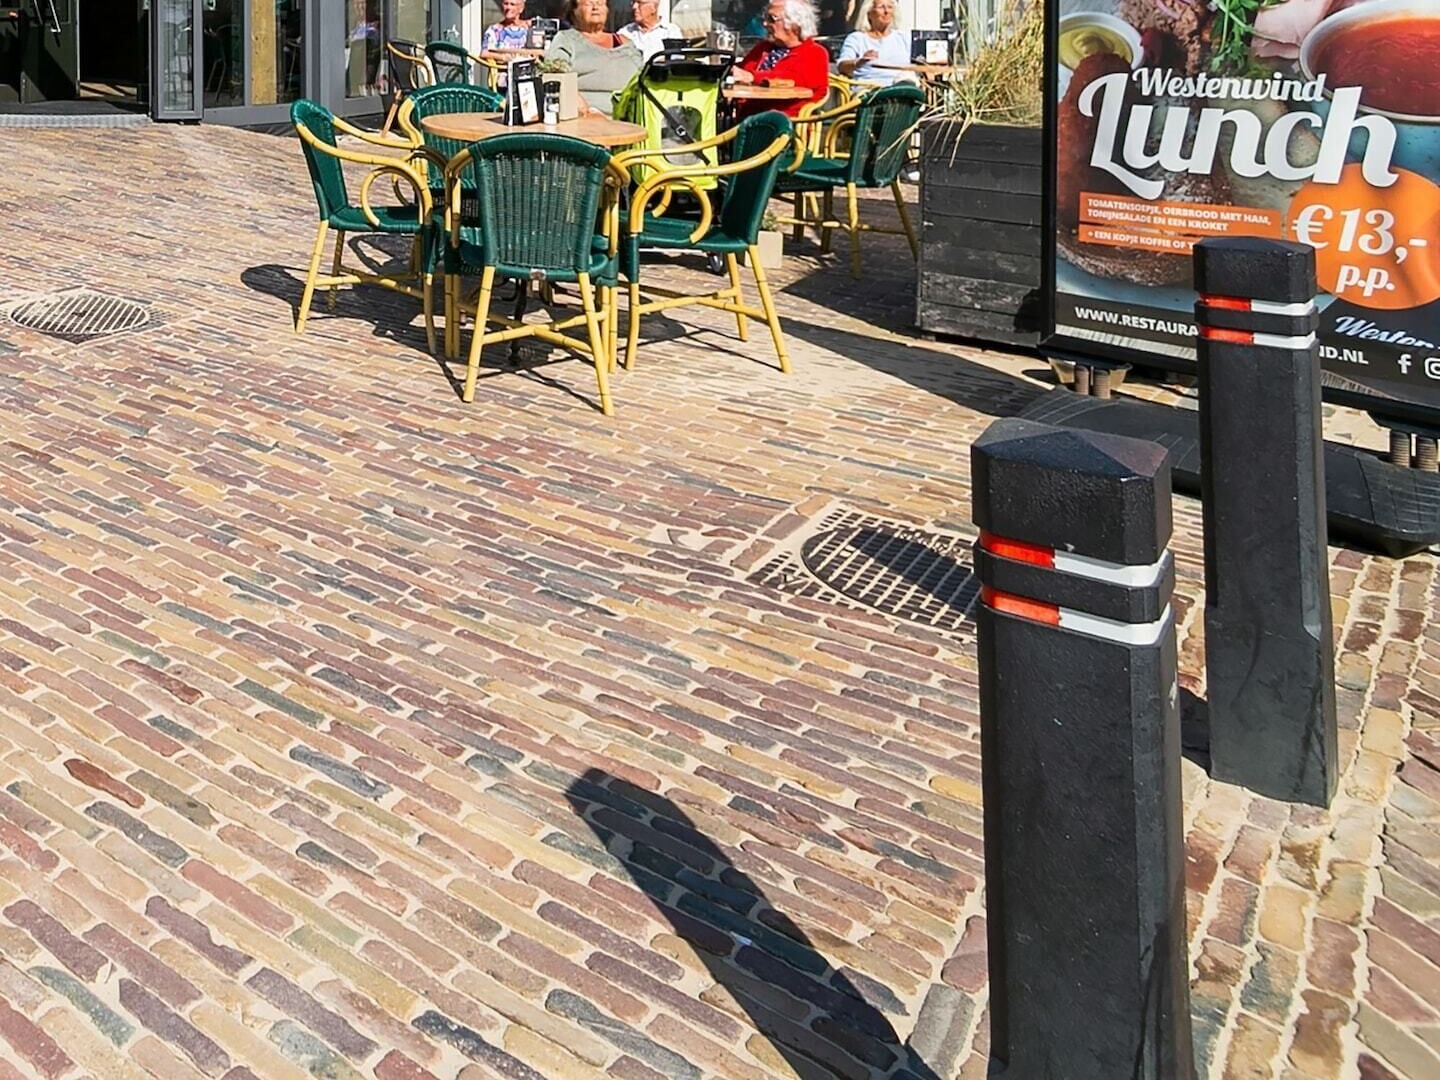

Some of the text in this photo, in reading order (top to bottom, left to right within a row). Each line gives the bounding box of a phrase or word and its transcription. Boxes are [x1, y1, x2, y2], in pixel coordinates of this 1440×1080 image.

[1132, 67, 1327, 103] Westenwind
[1078, 72, 1399, 200] Lunch
[1088, 209, 1229, 231] TONIJNSALADE EN EEN KROKET
[1163, 207, 1218, 220] OERBROOD
[1220, 211, 1242, 221] MET
[1243, 214, 1272, 226] HAM,
[1094, 230, 1112, 240] EEN
[1113, 232, 1139, 245] KOPJE
[1140, 234, 1171, 247] KOFFIE
[1172, 239, 1186, 249] OF
[1336, 265, 1395, 297] p.p.
